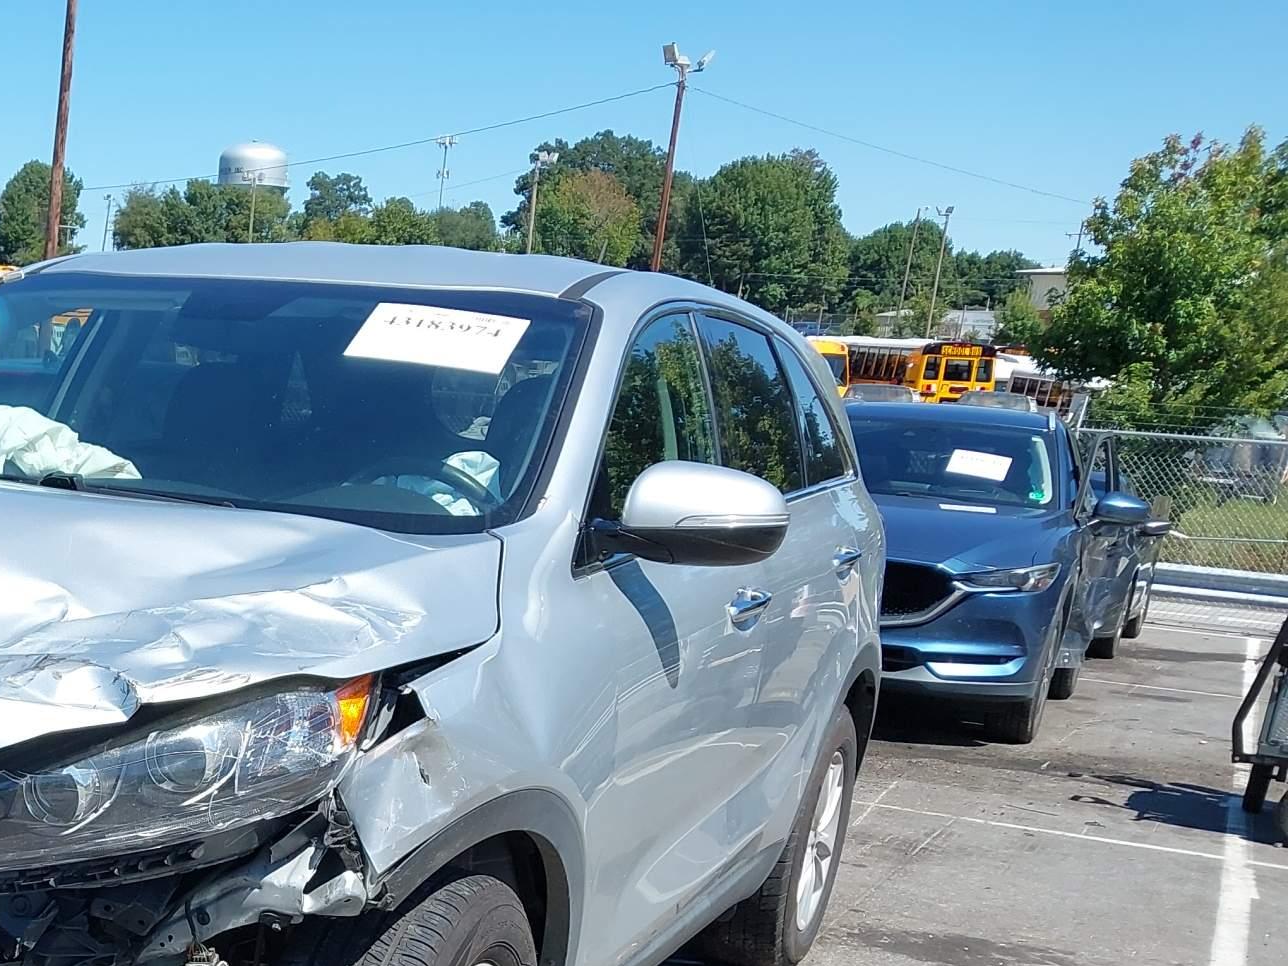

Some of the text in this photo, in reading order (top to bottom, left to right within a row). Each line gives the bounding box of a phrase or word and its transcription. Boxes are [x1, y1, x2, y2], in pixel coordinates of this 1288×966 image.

[384, 316, 501, 337] 43183974
[943, 346, 981, 355] SCHOOL BUS
